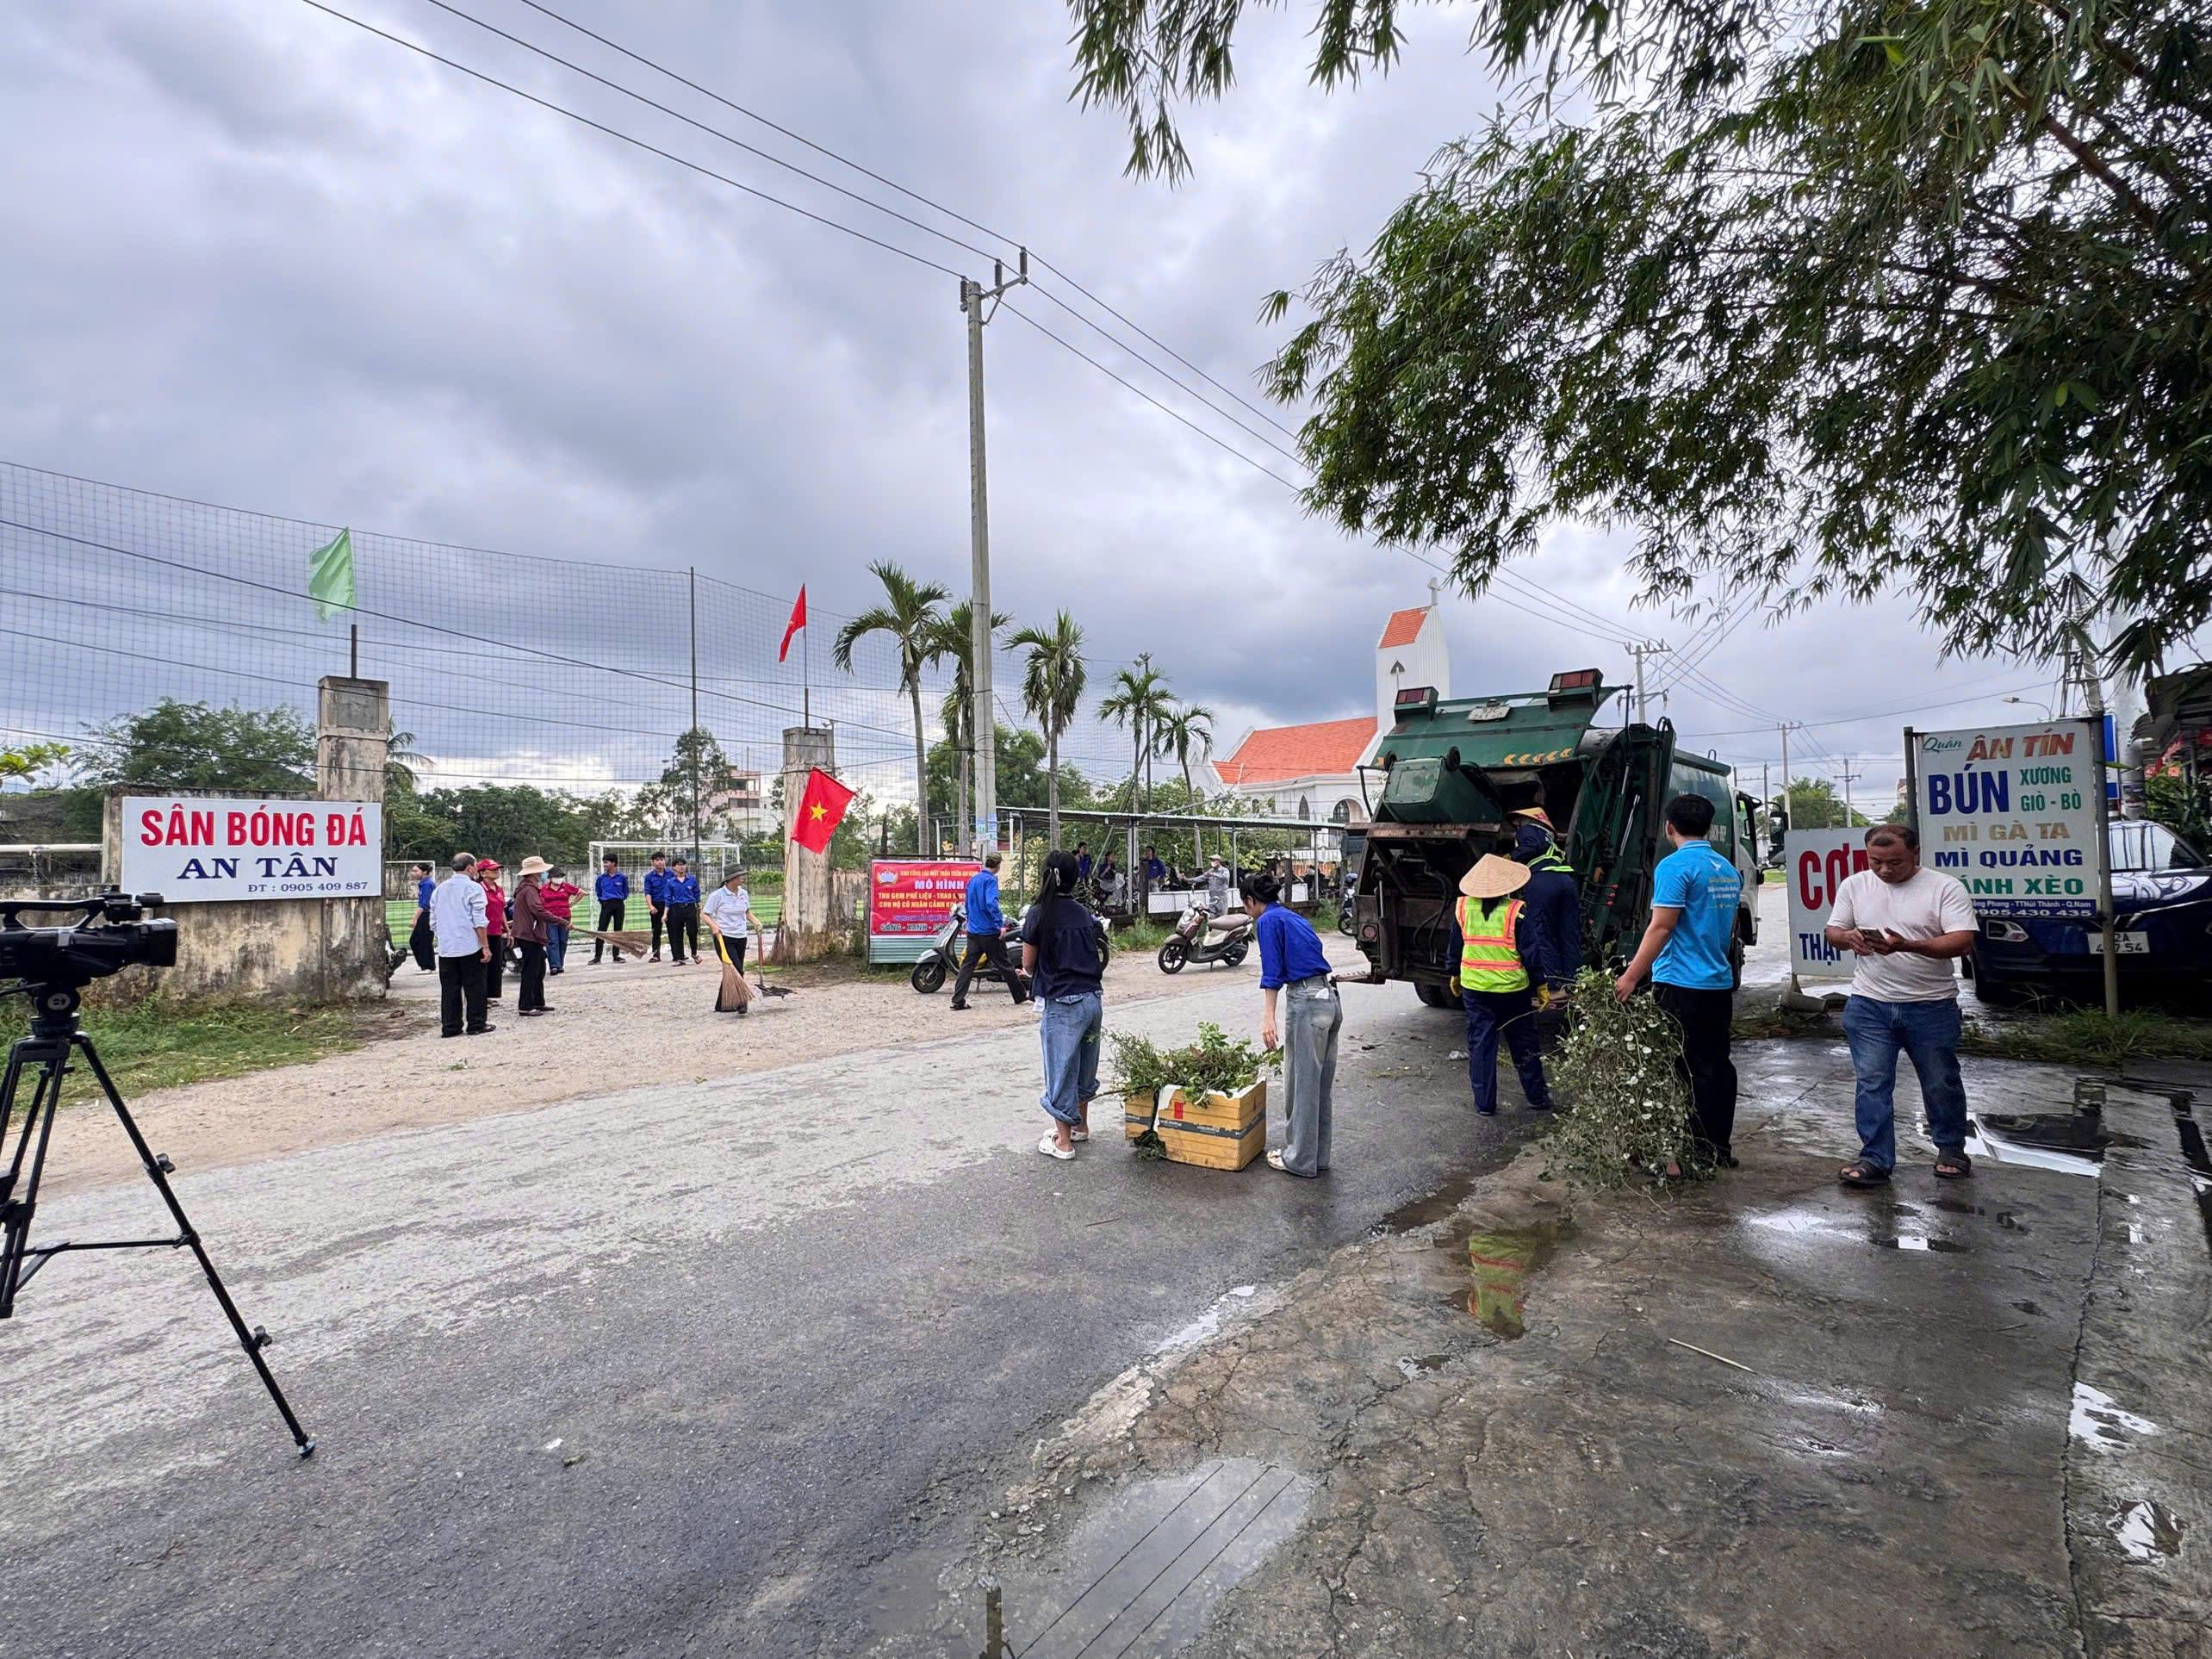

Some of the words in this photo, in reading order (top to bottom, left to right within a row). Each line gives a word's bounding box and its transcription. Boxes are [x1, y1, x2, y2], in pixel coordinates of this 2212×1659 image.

[1923, 736, 1964, 753] Quán
[1966, 734, 2015, 761] ÂN
[2022, 728, 2075, 757] TÍN
[2019, 766, 2072, 786] XƯƠNG
[1928, 763, 2010, 815] BÚN
[2021, 791, 2046, 812] GIÒ
[2060, 789, 2082, 811] BÒ
[140, 803, 214, 847] SÂN
[227, 805, 315, 847] BÓNG
[326, 807, 367, 846] ĐÁ
[1942, 822, 1979, 842] MÌ
[1988, 819, 2028, 841] GÀ
[2035, 822, 2071, 839] TA
[177, 858, 240, 879] AN
[256, 852, 339, 878] TÂN
[1935, 847, 1969, 867] MÌ
[1979, 844, 2083, 869] QUẢNG
[247, 884, 268, 893] ĐT
[281, 883, 314, 892] 0905
[318, 882, 341, 892] 409
[345, 881, 368, 891] 887
[914, 879, 933, 890] MÔ
[935, 879, 965, 890] HÌNH
[1799, 842, 1870, 910] CƠ
[1960, 874, 2013, 895] ÁNH
[2024, 874, 2084, 895] XÈO
[2095, 942, 2143, 952] 47.54
[2114, 933, 2130, 942] 2A
